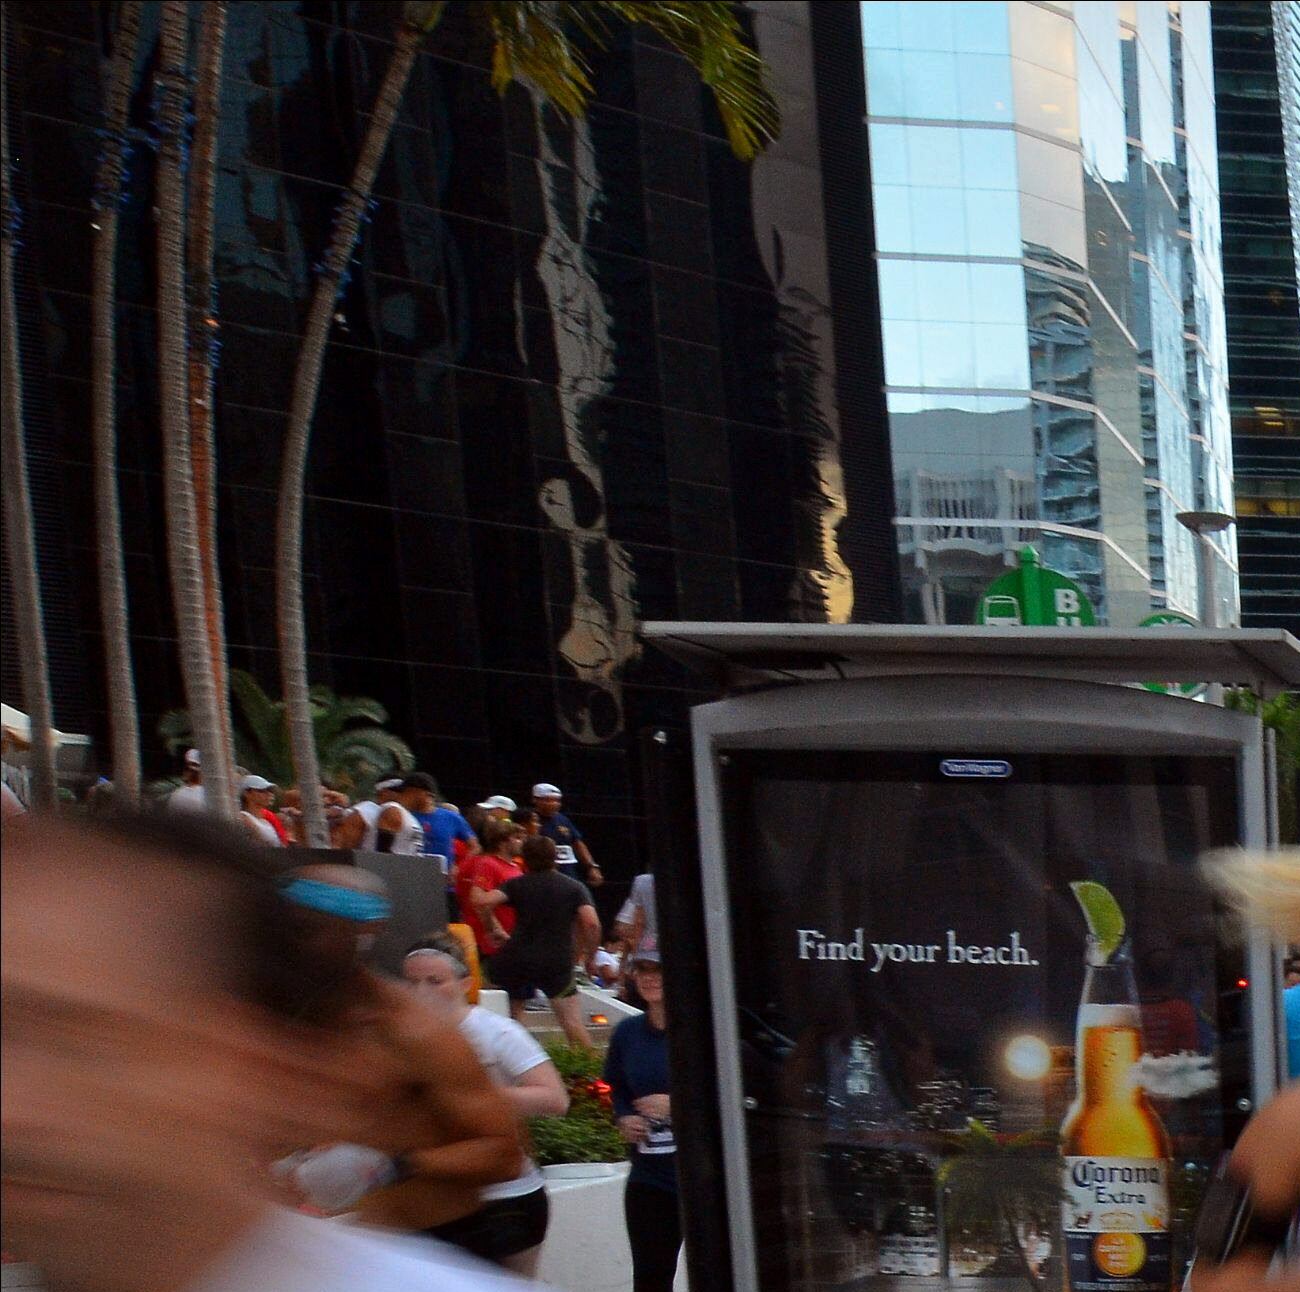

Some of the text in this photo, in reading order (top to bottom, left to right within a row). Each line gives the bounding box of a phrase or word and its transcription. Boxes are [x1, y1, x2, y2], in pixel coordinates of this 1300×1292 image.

[797, 927, 1040, 973] Find your beach.
[1072, 1160, 1162, 1191] Corona
[1095, 1186, 1147, 1205] Extra
